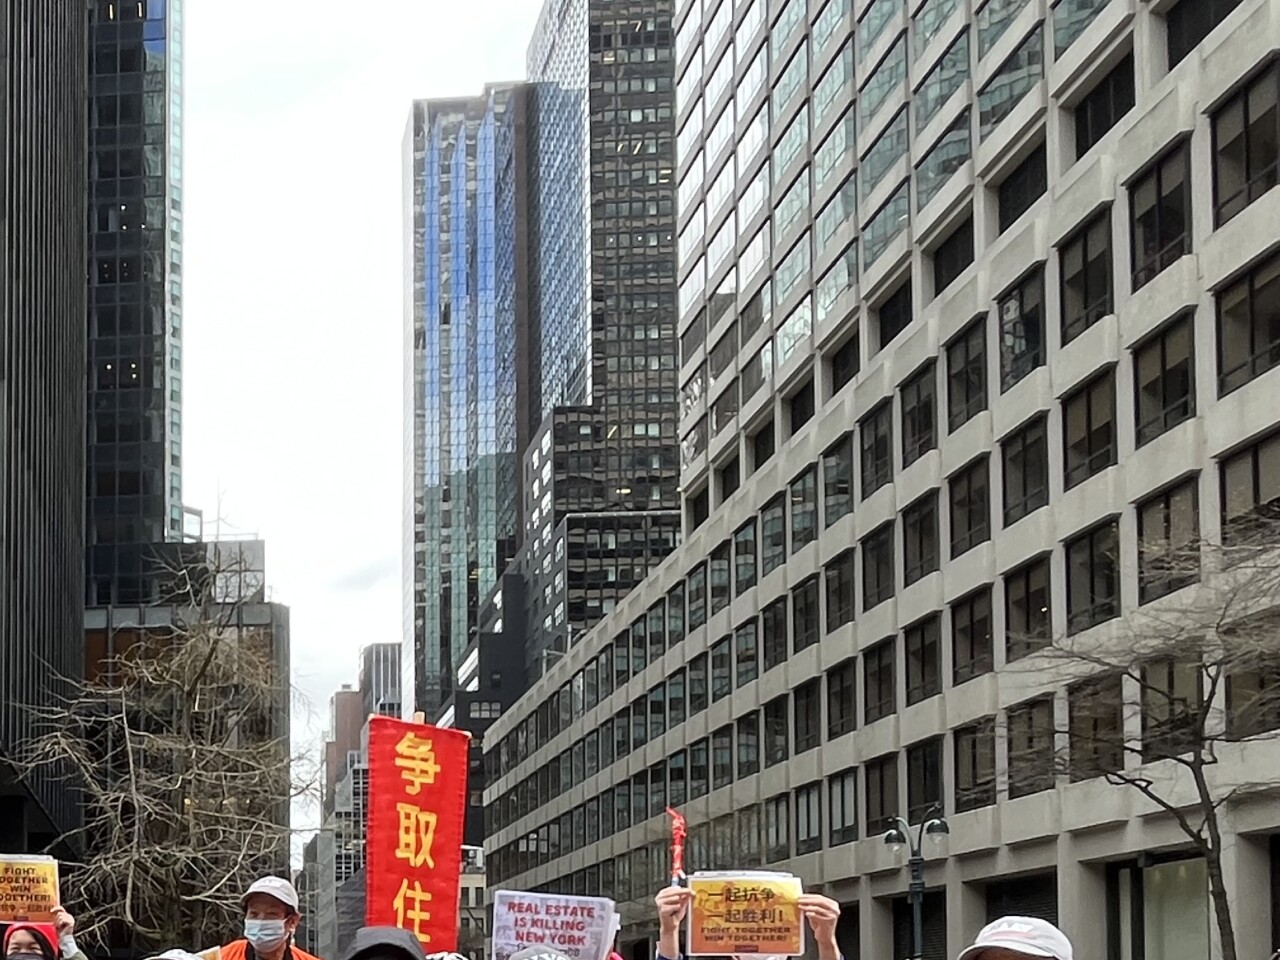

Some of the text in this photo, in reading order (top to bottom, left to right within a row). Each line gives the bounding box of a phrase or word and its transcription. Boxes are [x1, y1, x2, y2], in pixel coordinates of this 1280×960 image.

[393, 731, 441, 943] 争取住
[4, 867, 36, 875] FIGHT
[10, 885, 31, 893] WIN
[708, 887, 775, 902] 一起抗争
[507, 902, 596, 918] REAL ESTATE
[515, 917, 586, 931] IS KILLING
[515, 931, 587, 946] NEW YORK
